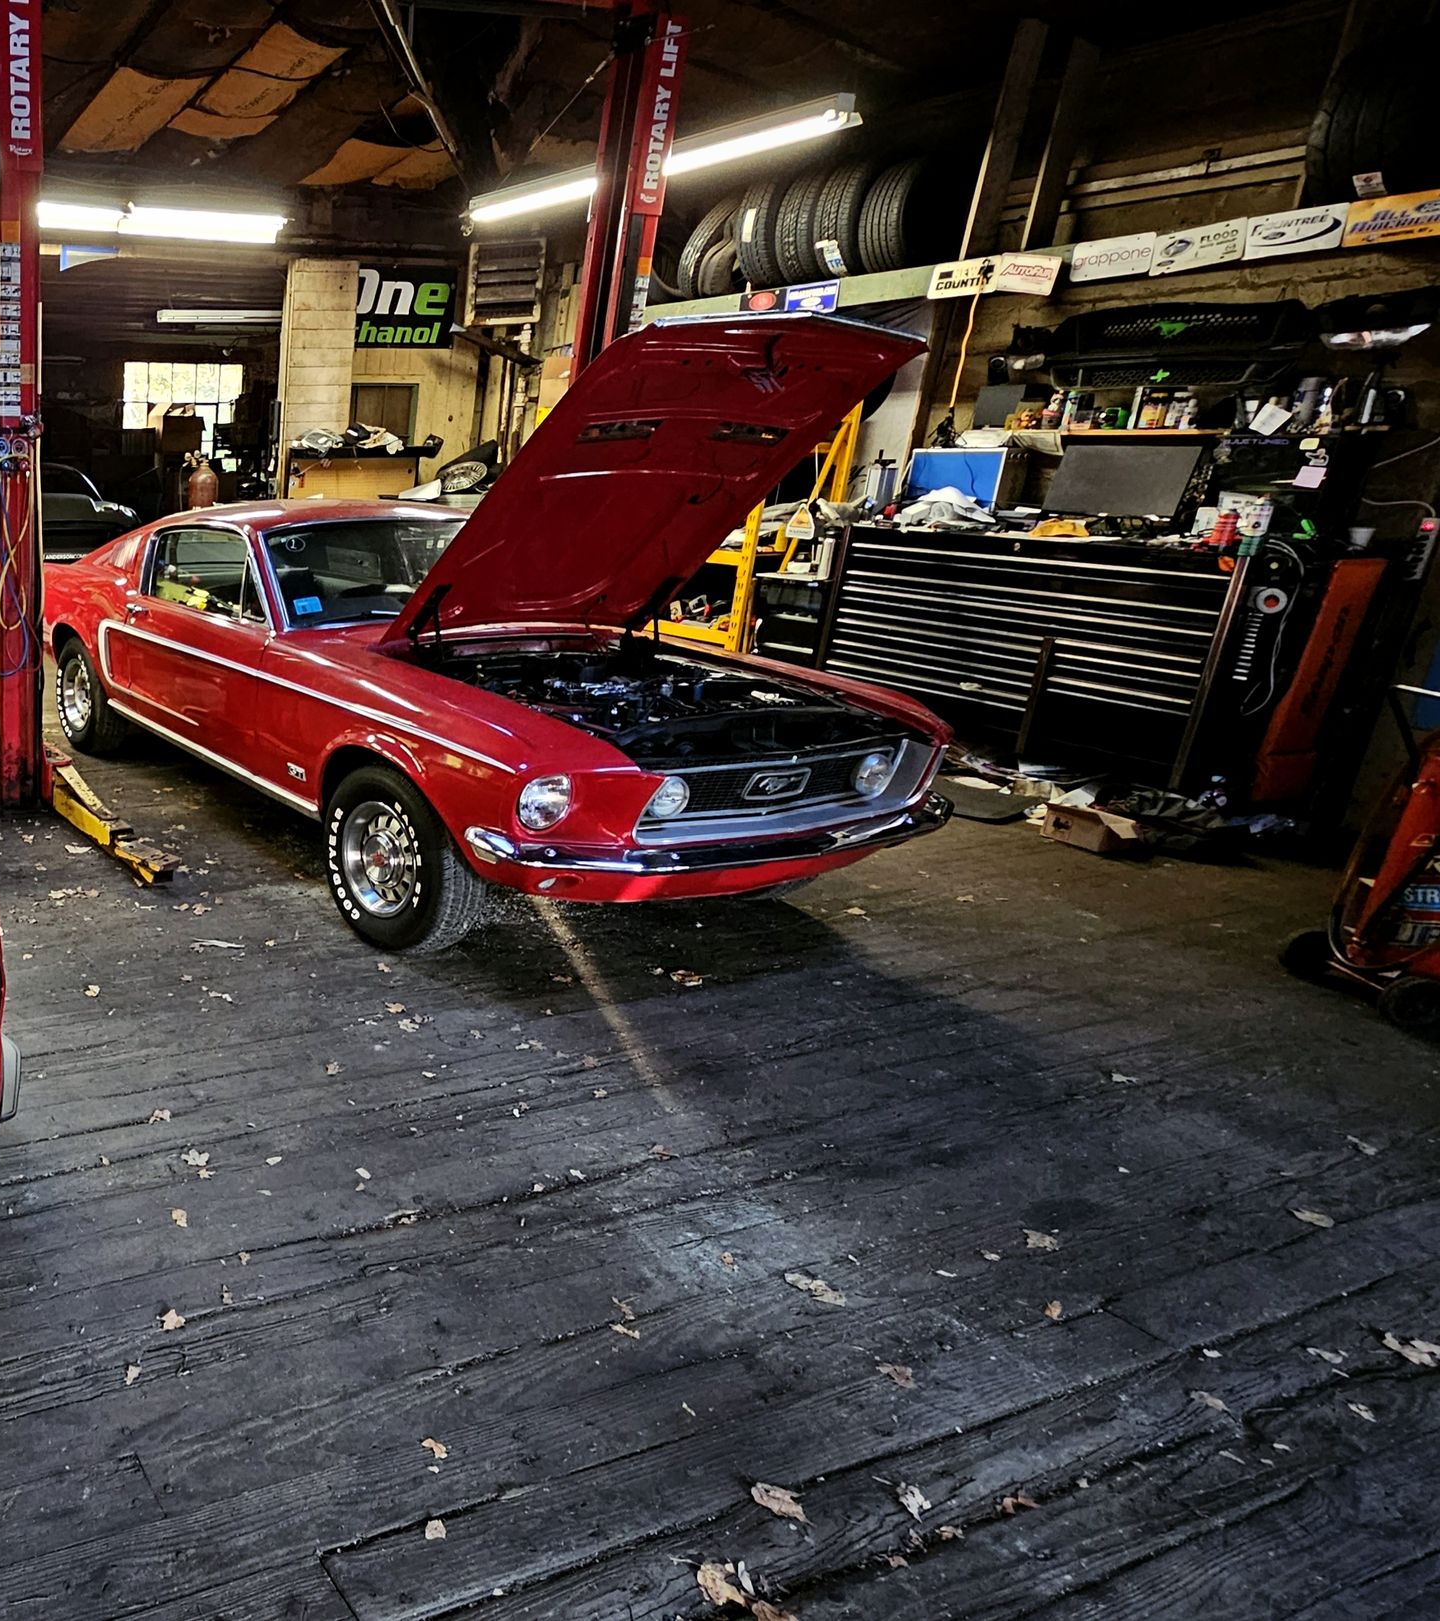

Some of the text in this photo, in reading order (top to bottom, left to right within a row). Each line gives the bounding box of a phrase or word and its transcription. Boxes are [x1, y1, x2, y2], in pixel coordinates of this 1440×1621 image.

[9, 12, 30, 139] ROTARY
[643, 20, 683, 190] ROTARY LIFT
[1350, 214, 1440, 233] AMERICA
[1200, 229, 1239, 244] FLOOD
[1073, 246, 1151, 271] grappone
[357, 321, 441, 343] hanol
[329, 807, 360, 920] GOODYEAR
